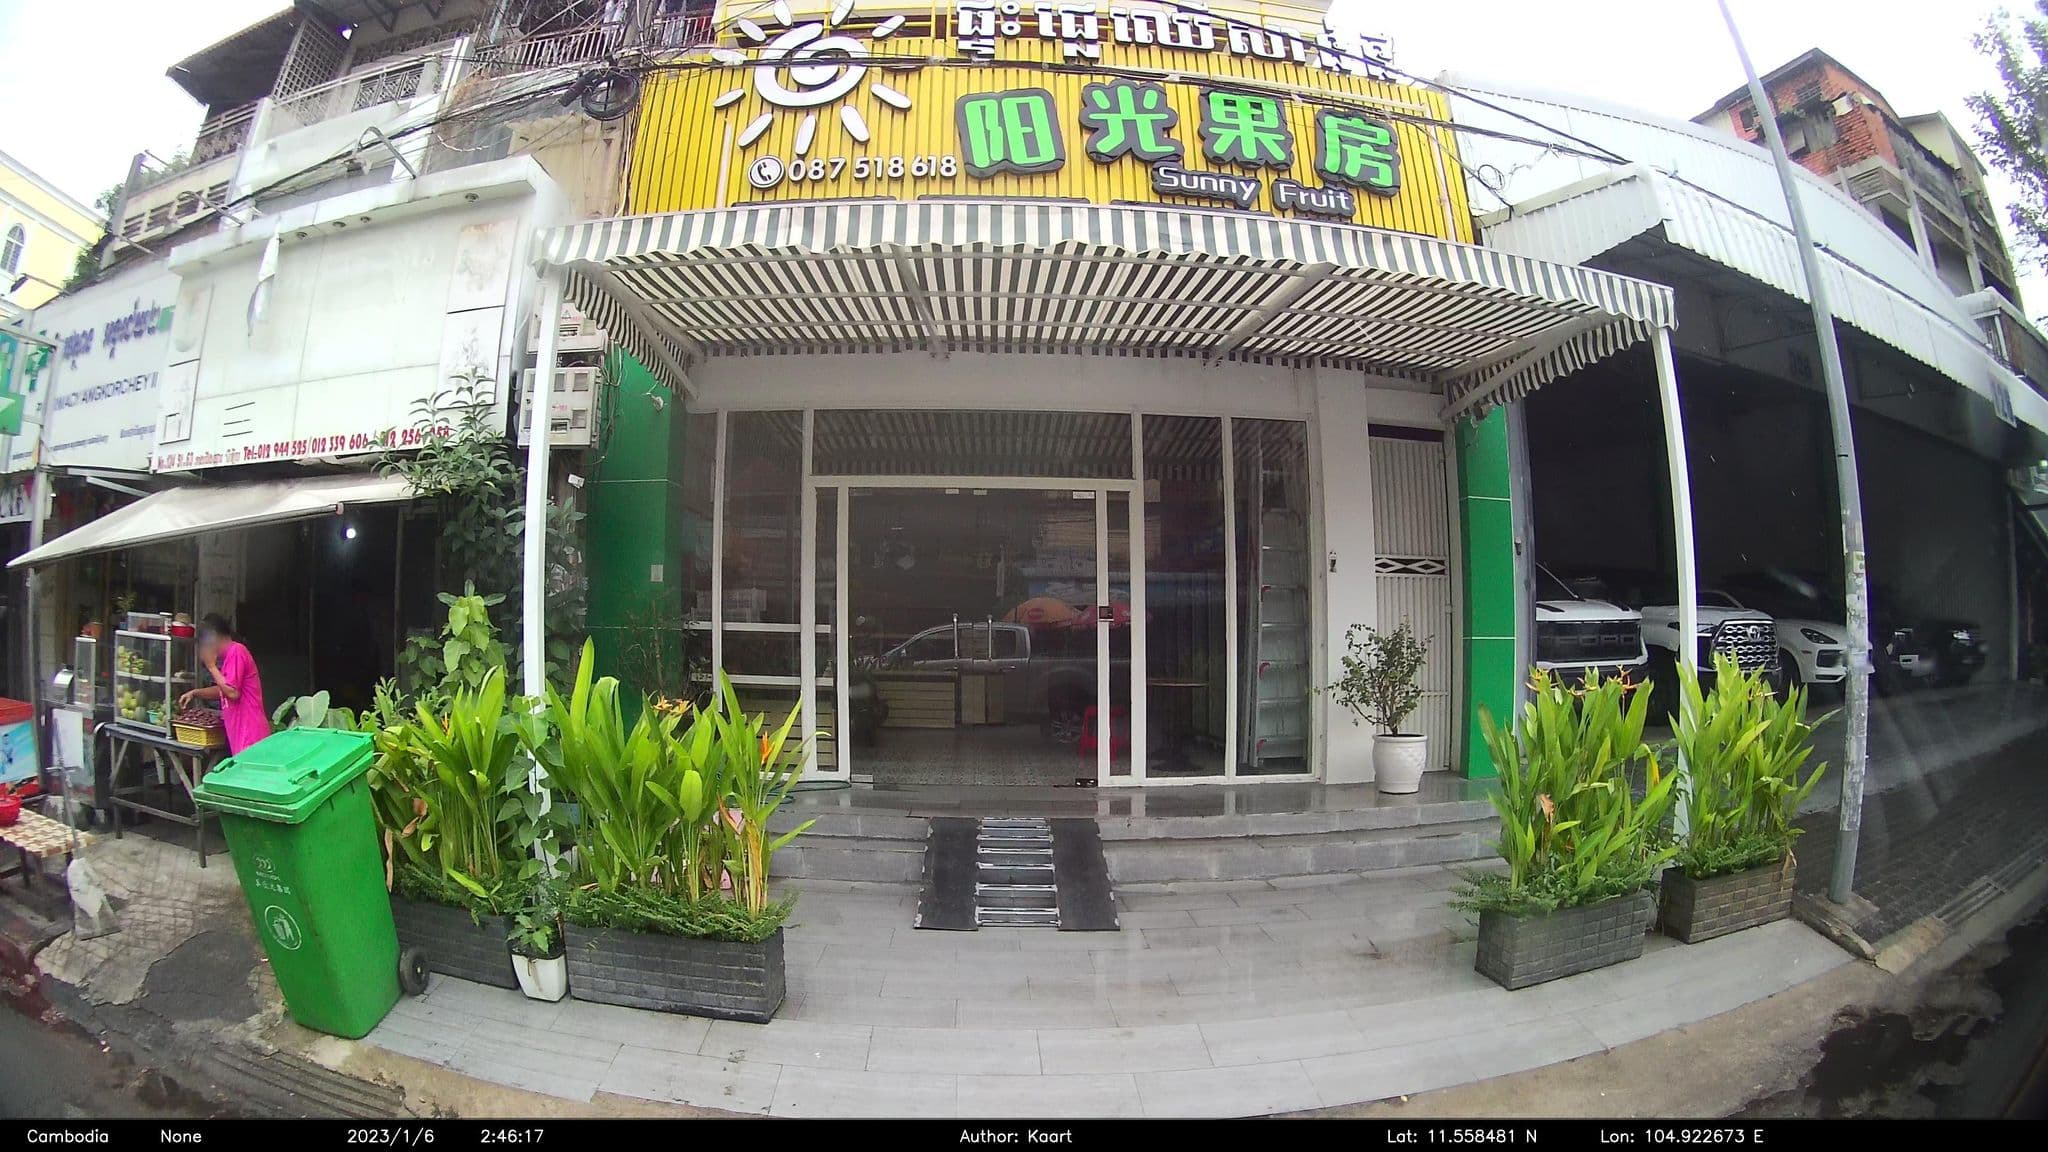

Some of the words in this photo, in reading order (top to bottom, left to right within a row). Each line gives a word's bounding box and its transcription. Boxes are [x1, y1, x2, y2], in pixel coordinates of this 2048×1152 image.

[964, 82, 1398, 191] 阳光果房
[787, 156, 847, 182] 087
[853, 156, 905, 179] 518
[911, 154, 957, 178] 618
[1158, 164, 1257, 202] Sunny
[1278, 182, 1352, 211] Fruit
